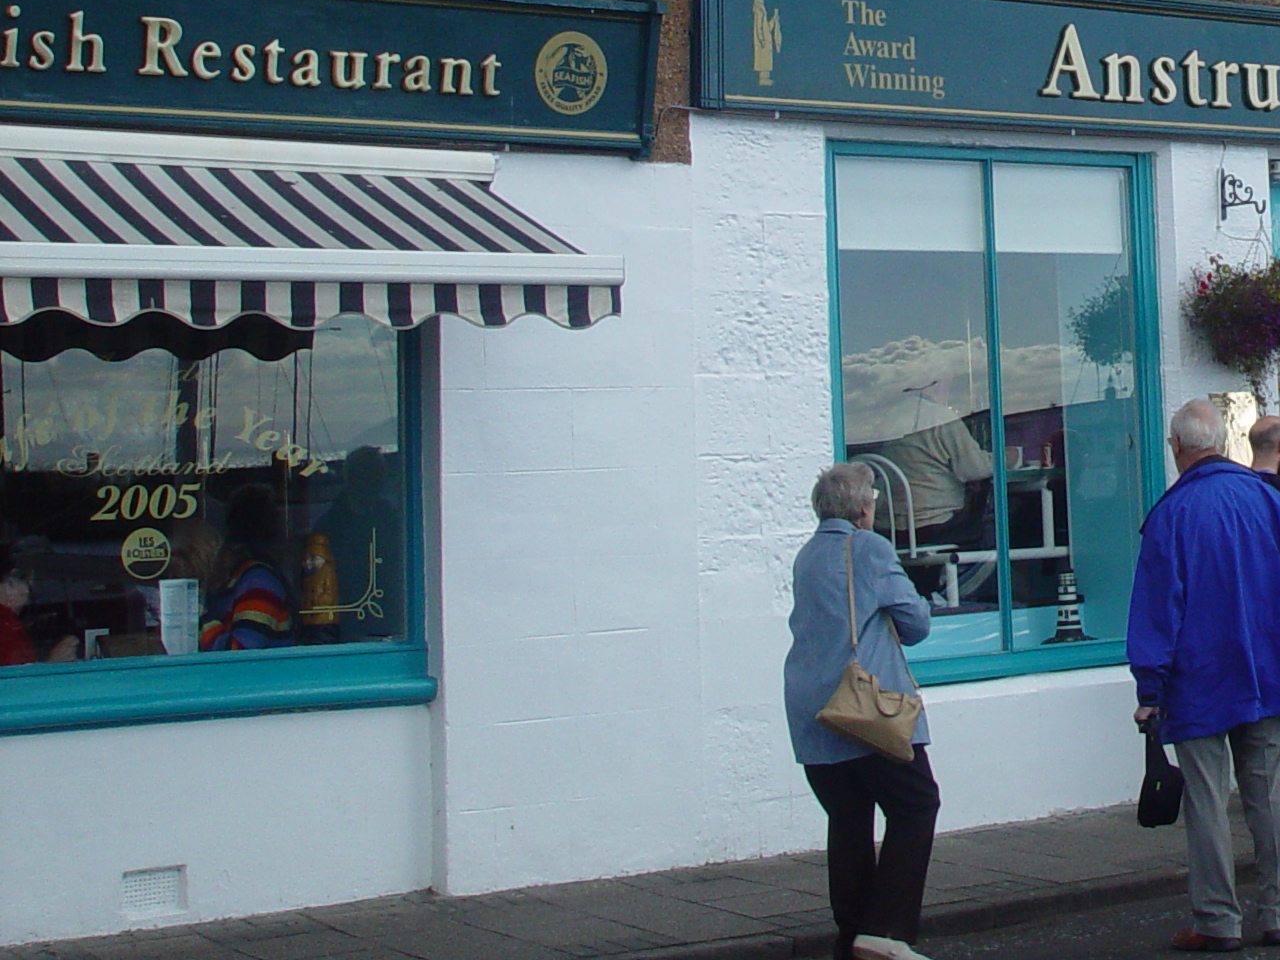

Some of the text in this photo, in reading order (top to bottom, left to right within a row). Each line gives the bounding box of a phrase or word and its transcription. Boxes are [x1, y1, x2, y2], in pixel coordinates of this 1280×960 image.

[842, 0, 887, 26] The
[138, 16, 502, 97] Restaurant
[843, 31, 916, 60] Award
[553, 71, 591, 86] SEAFISH
[843, 63, 945, 99] Winning
[234, 406, 330, 478] Year
[56, 444, 232, 477] Scotland
[90, 483, 201, 521] 2005
[138, 536, 155, 548] LES
